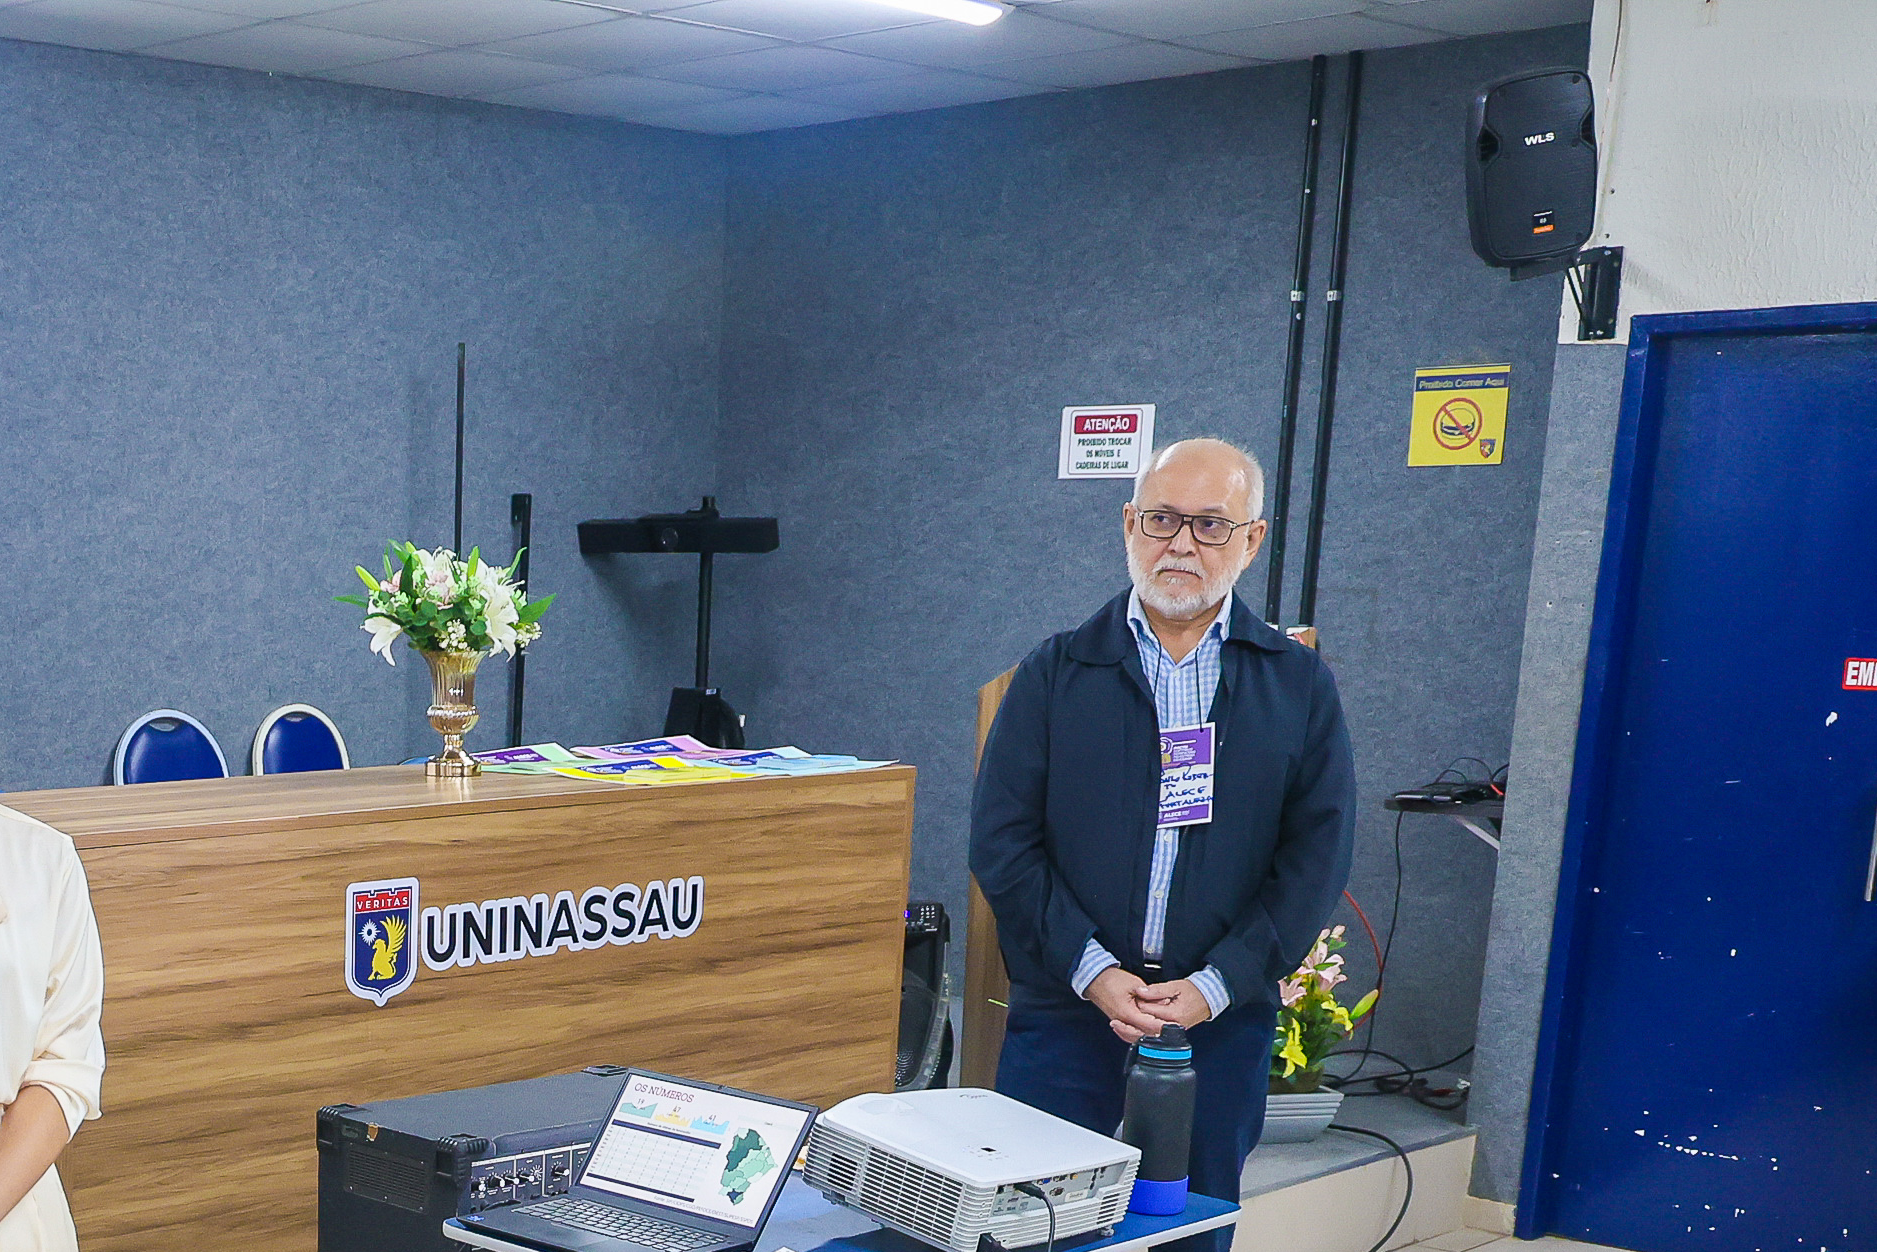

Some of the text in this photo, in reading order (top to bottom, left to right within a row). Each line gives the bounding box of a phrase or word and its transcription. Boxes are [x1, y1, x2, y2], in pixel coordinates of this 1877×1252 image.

[1524, 132, 1555, 146] WLS
[1083, 416, 1130, 432] ATENÇÃO
[1077, 437, 1132, 446] PROIBIDO TROCAR
[1086, 449, 1093, 457] OS
[1117, 449, 1121, 457] E
[1076, 460, 1129, 469] CADEIRAS DE LUGAR
[1845, 661, 1877, 686] EM
[356, 895, 409, 910] VERITAS
[427, 883, 698, 963] UNINASSAU
[634, 1083, 695, 1103] OS NÚMEROS
